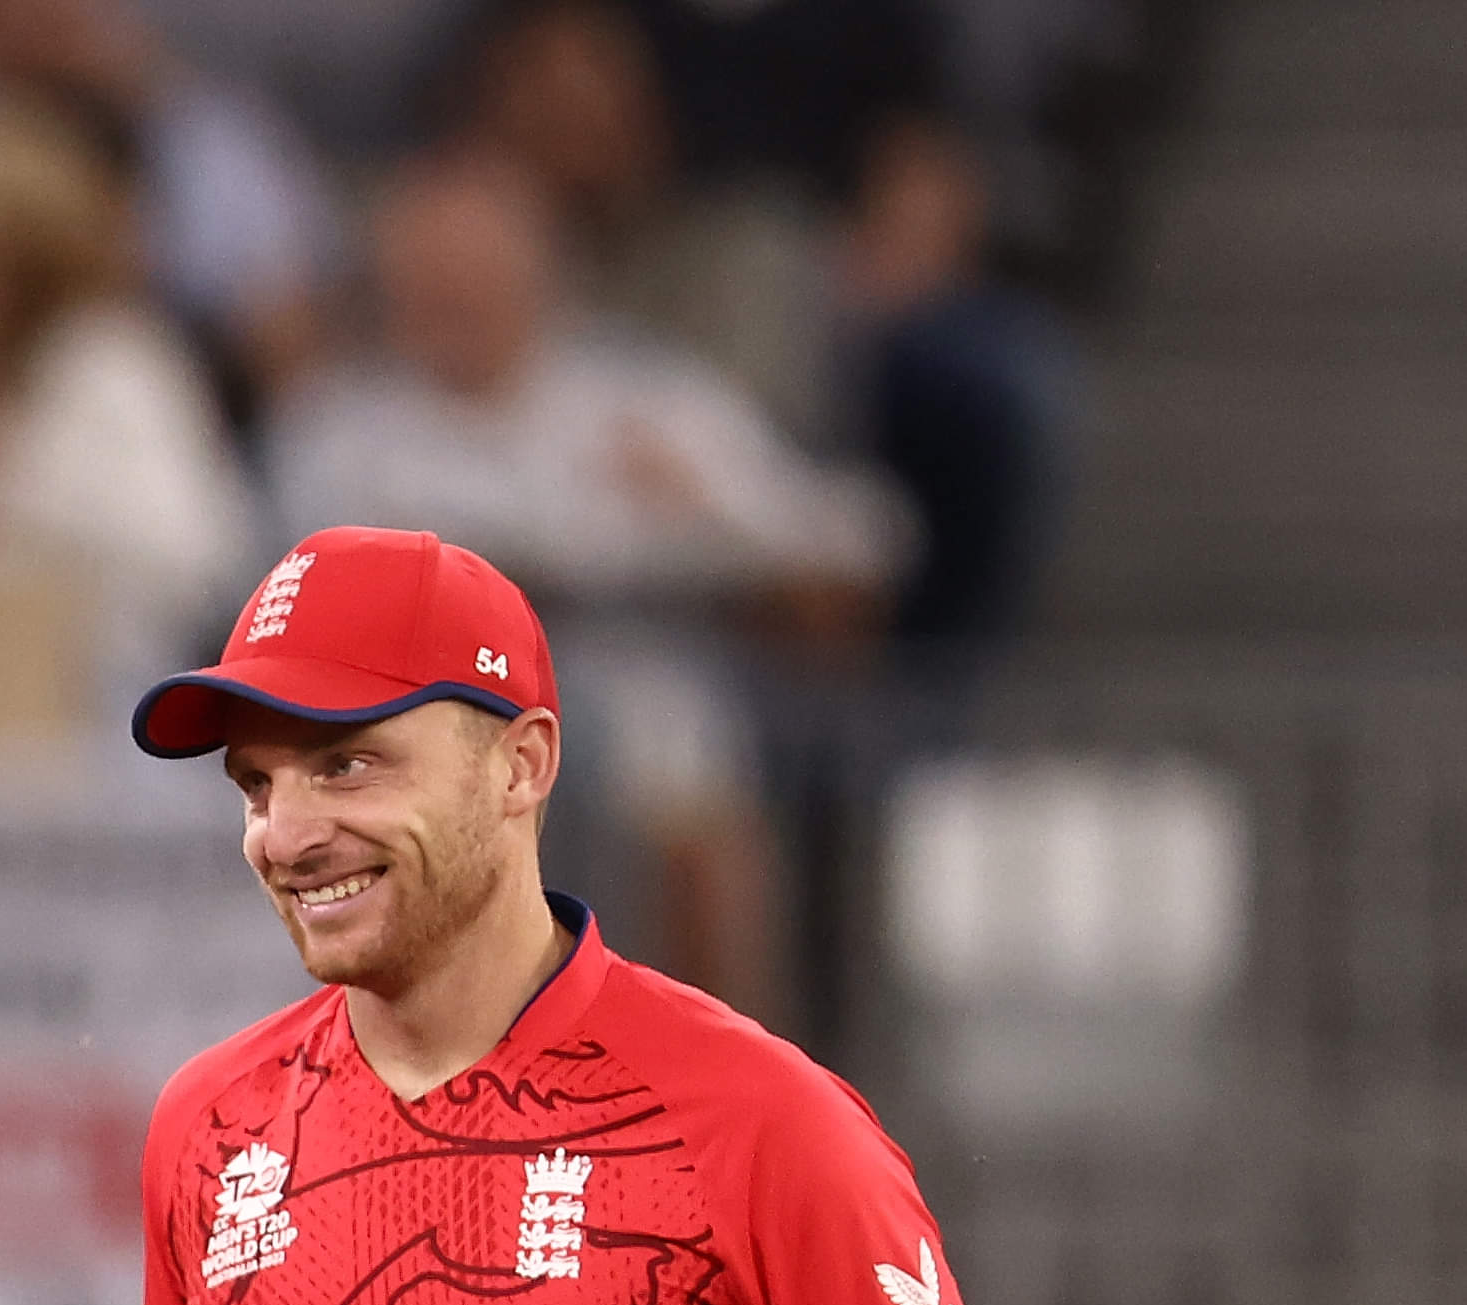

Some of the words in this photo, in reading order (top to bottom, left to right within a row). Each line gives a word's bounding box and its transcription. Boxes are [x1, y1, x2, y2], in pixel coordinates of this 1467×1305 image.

[474, 647, 509, 681] 54
[201, 1240, 258, 1278] WORLD
[259, 1227, 298, 1254] CUP
[207, 1221, 257, 1255] MEN'S
[257, 1210, 291, 1235] T20
